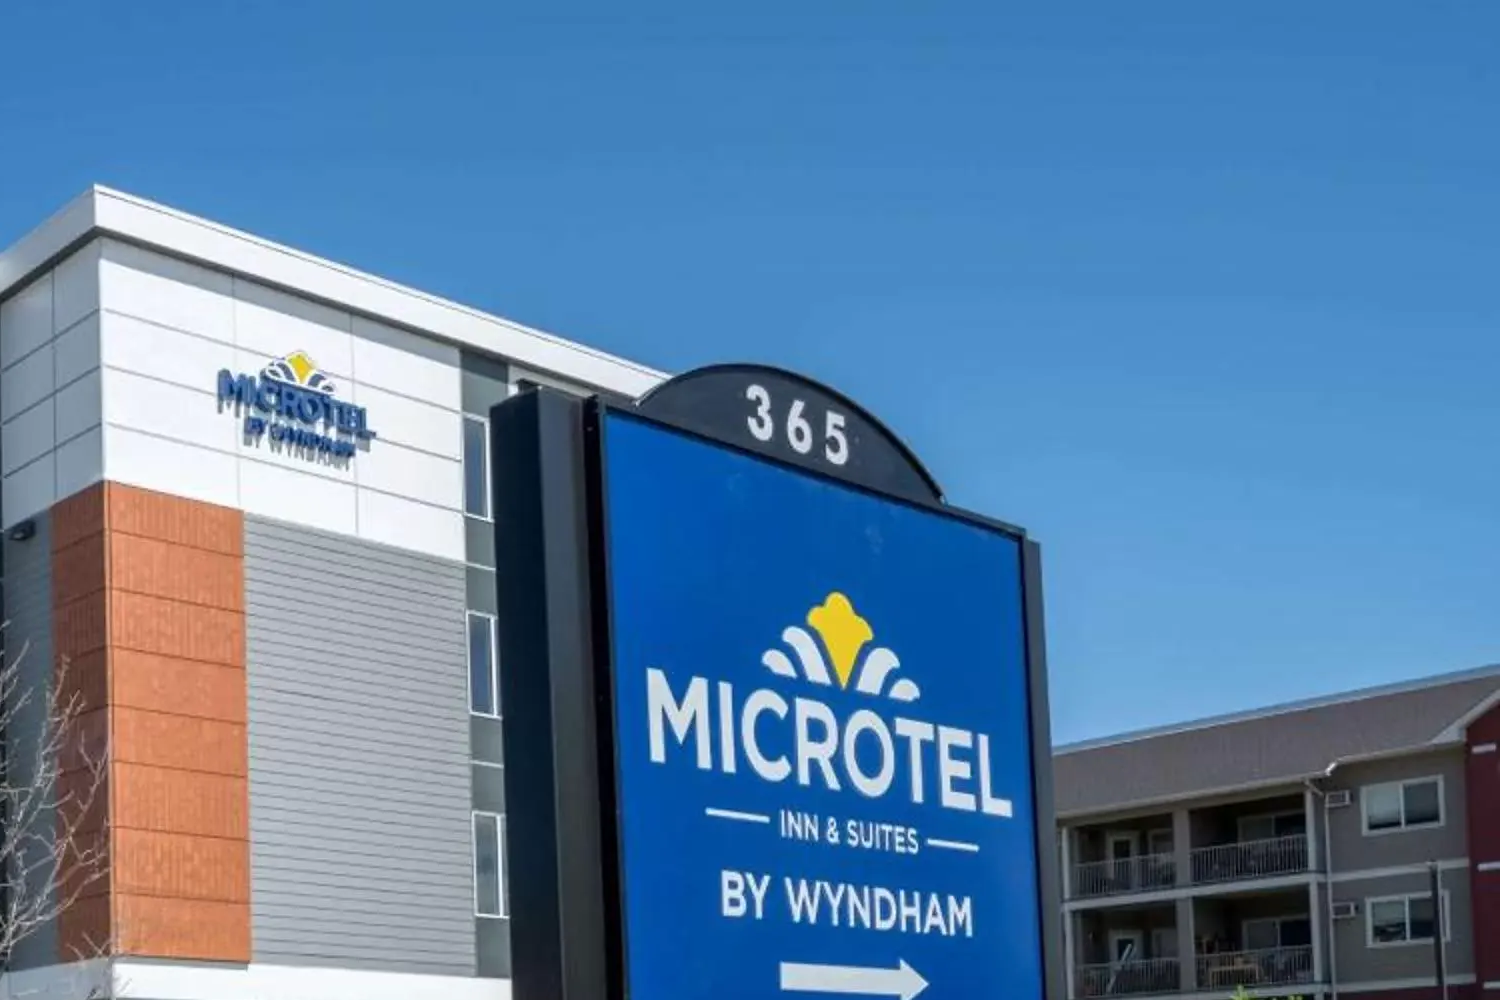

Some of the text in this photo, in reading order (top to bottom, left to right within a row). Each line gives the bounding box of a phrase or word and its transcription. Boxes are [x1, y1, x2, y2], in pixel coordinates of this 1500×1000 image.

[746, 384, 849, 465] 365
[646, 667, 1013, 818] MICROTEL
[780, 810, 919, 854] INN & SUITES
[721, 870, 973, 937] BY WYNDHAM
